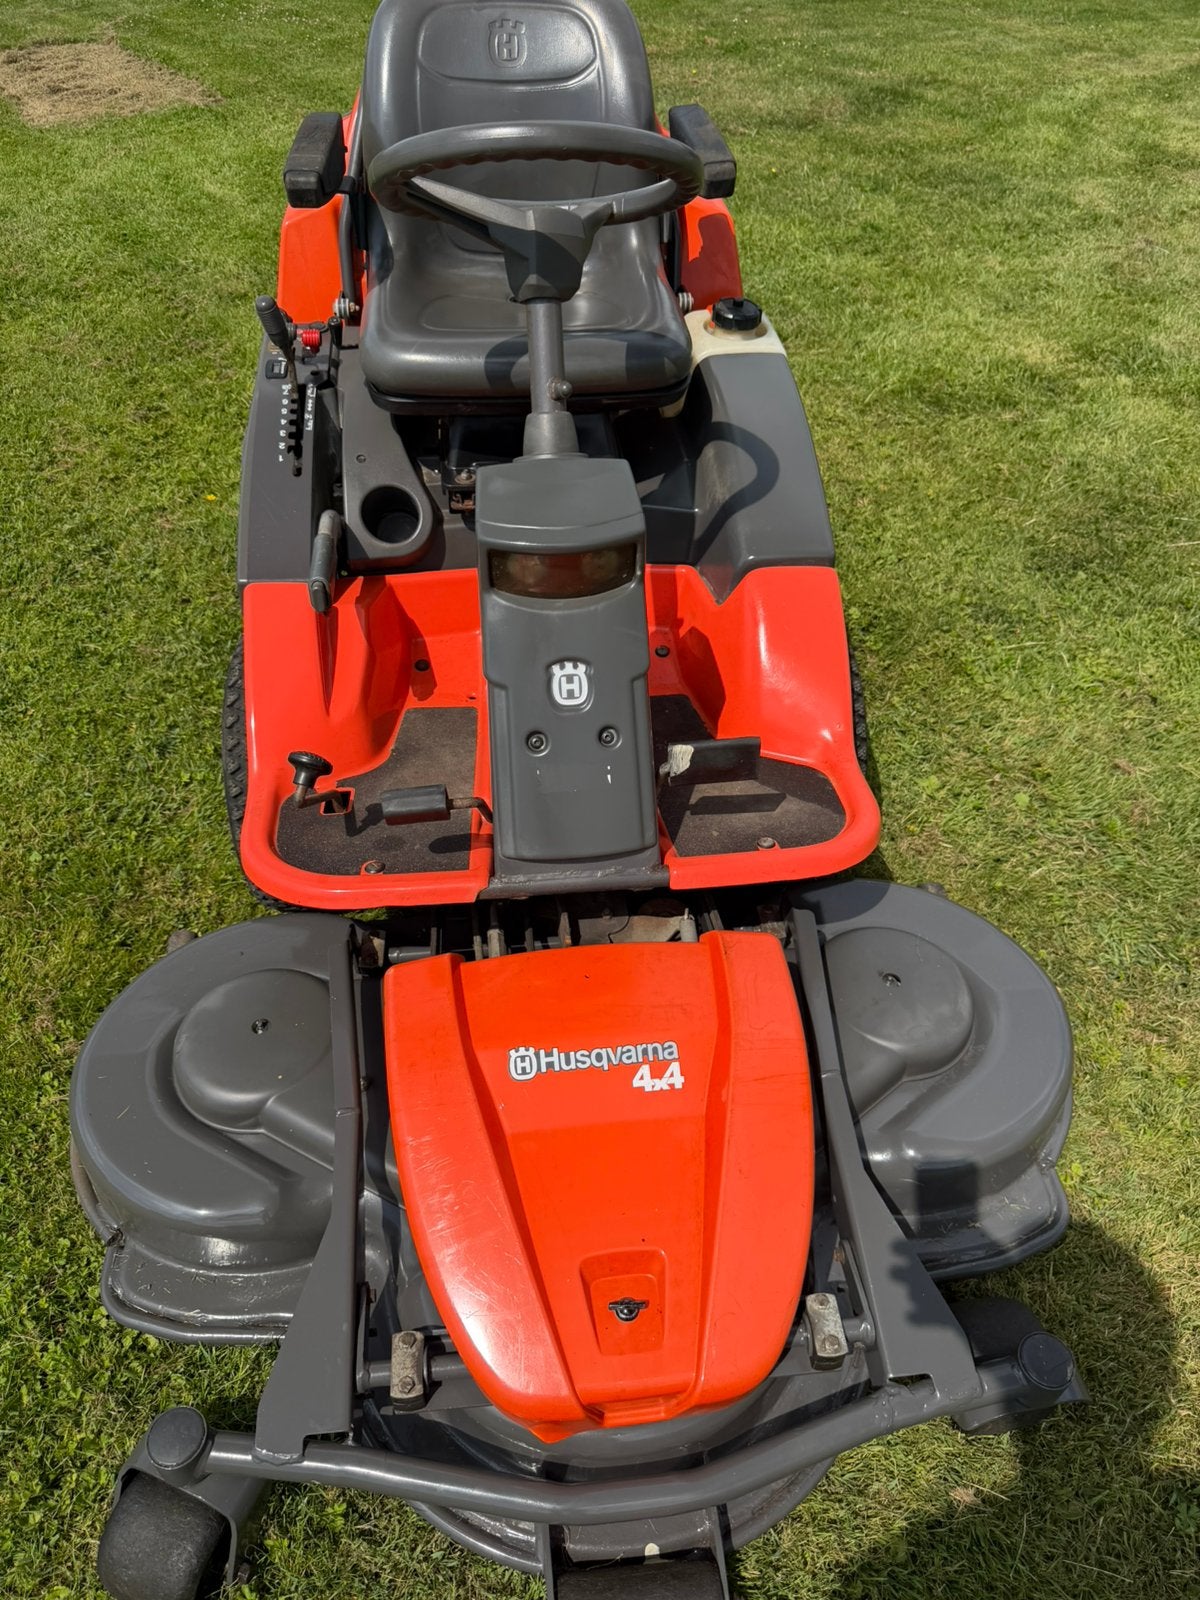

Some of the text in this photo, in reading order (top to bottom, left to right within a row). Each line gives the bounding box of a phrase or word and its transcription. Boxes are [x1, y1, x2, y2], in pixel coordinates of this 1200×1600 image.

[280, 418, 288, 426] 4
[279, 429, 287, 437] 3
[278, 442, 286, 450] 2
[278, 454, 284, 462] 1
[539, 1040, 679, 1073] Husqvarna
[632, 1061, 685, 1092] 4x4
